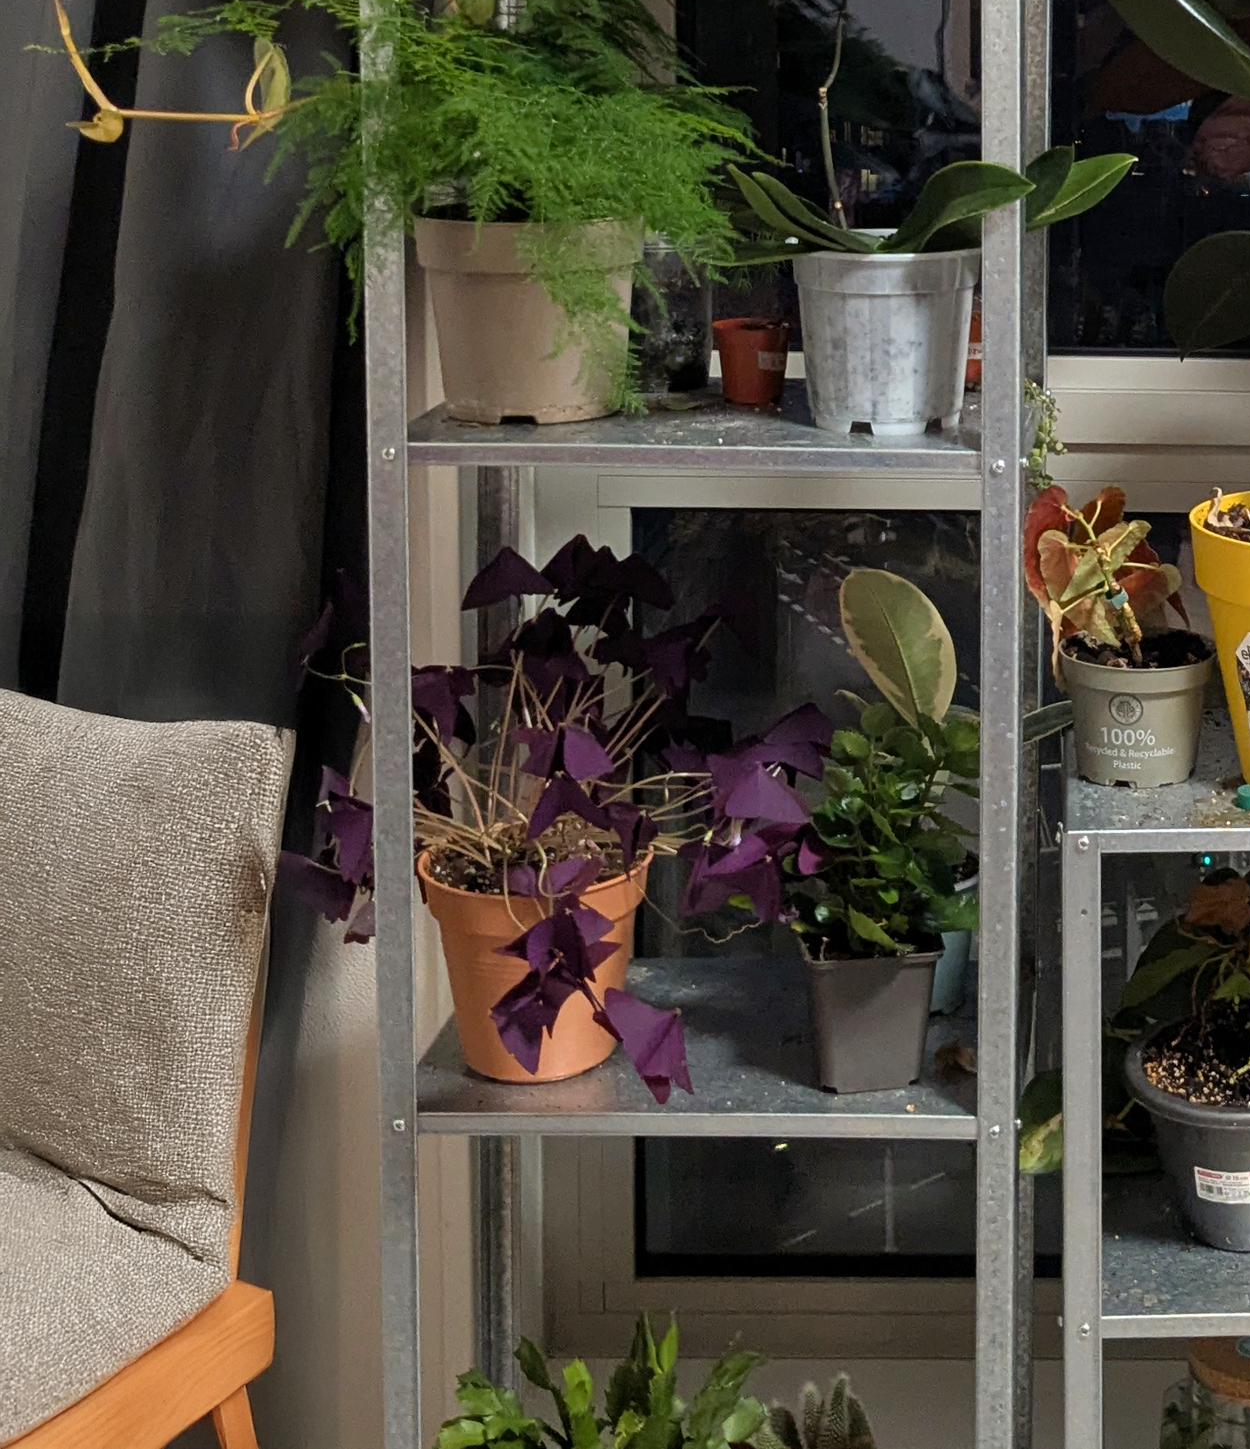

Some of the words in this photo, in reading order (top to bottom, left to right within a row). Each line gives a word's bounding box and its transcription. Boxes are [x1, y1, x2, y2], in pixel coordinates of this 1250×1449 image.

[1100, 727, 1156, 746] 100%
[1119, 749, 1127, 757] &
[1128, 747, 1175, 759] Recyclable
[1112, 760, 1142, 769] Plastic
